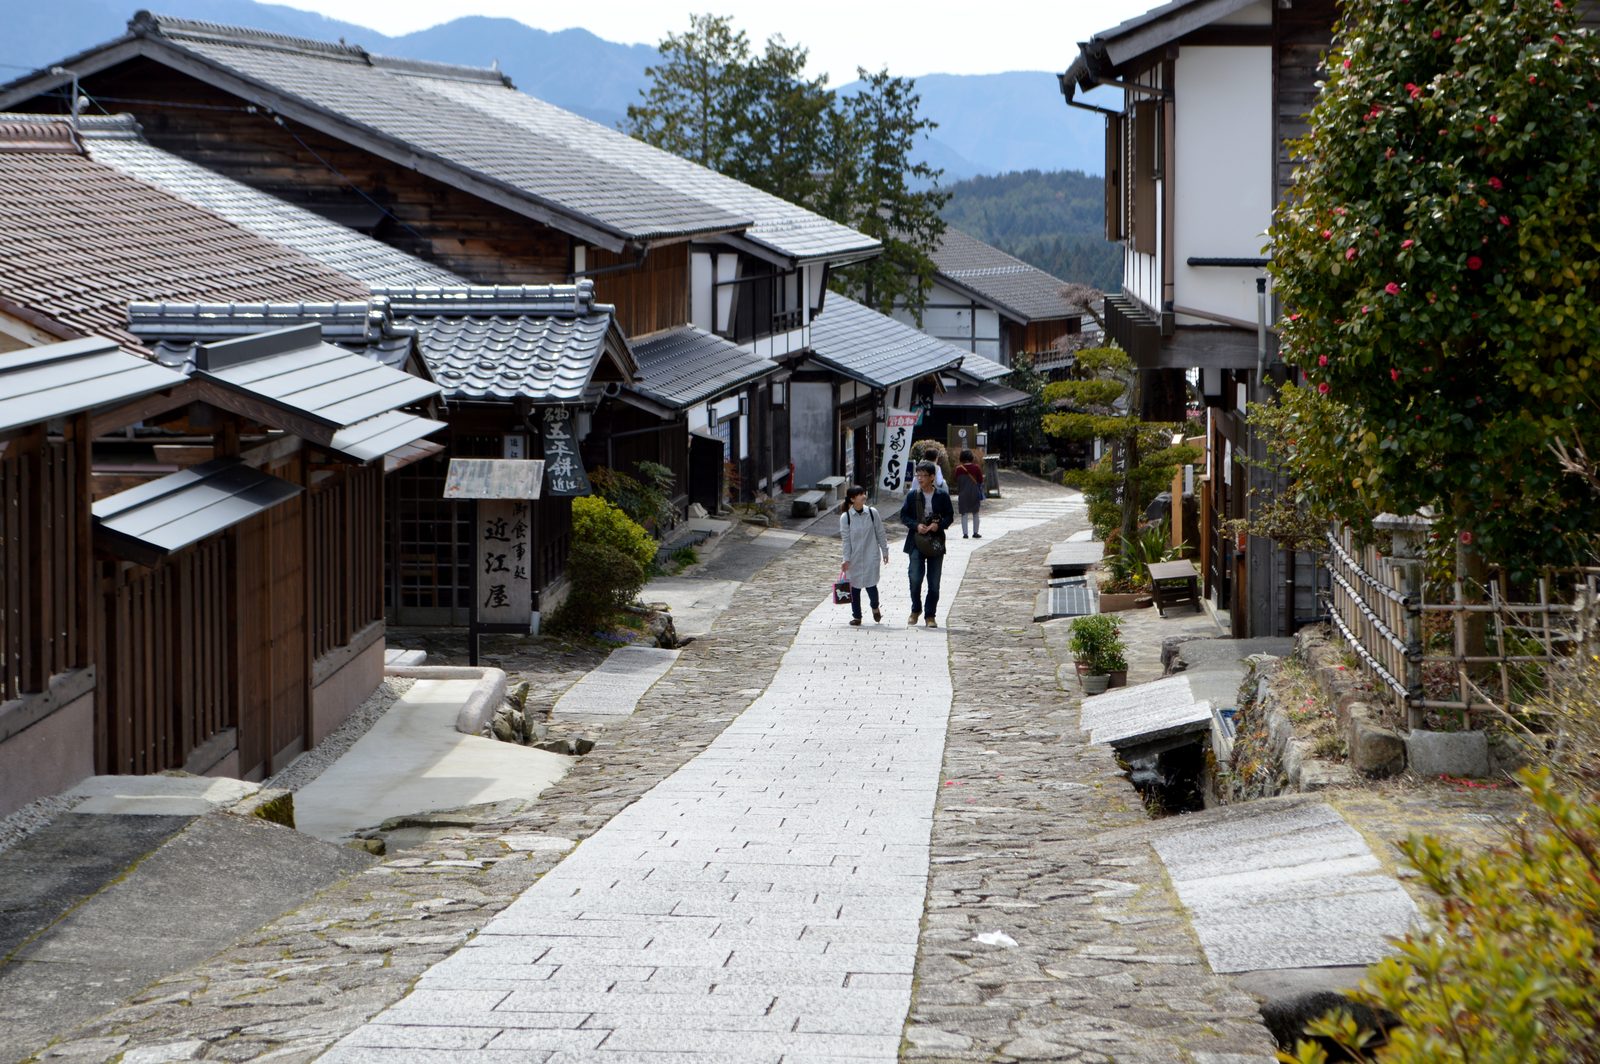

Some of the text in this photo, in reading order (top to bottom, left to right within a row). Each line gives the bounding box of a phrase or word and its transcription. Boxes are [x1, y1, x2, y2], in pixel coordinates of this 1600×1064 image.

[543, 407, 570, 422] 名物
[545, 422, 578, 477] 五平餅
[484, 517, 511, 609] 近江屋
